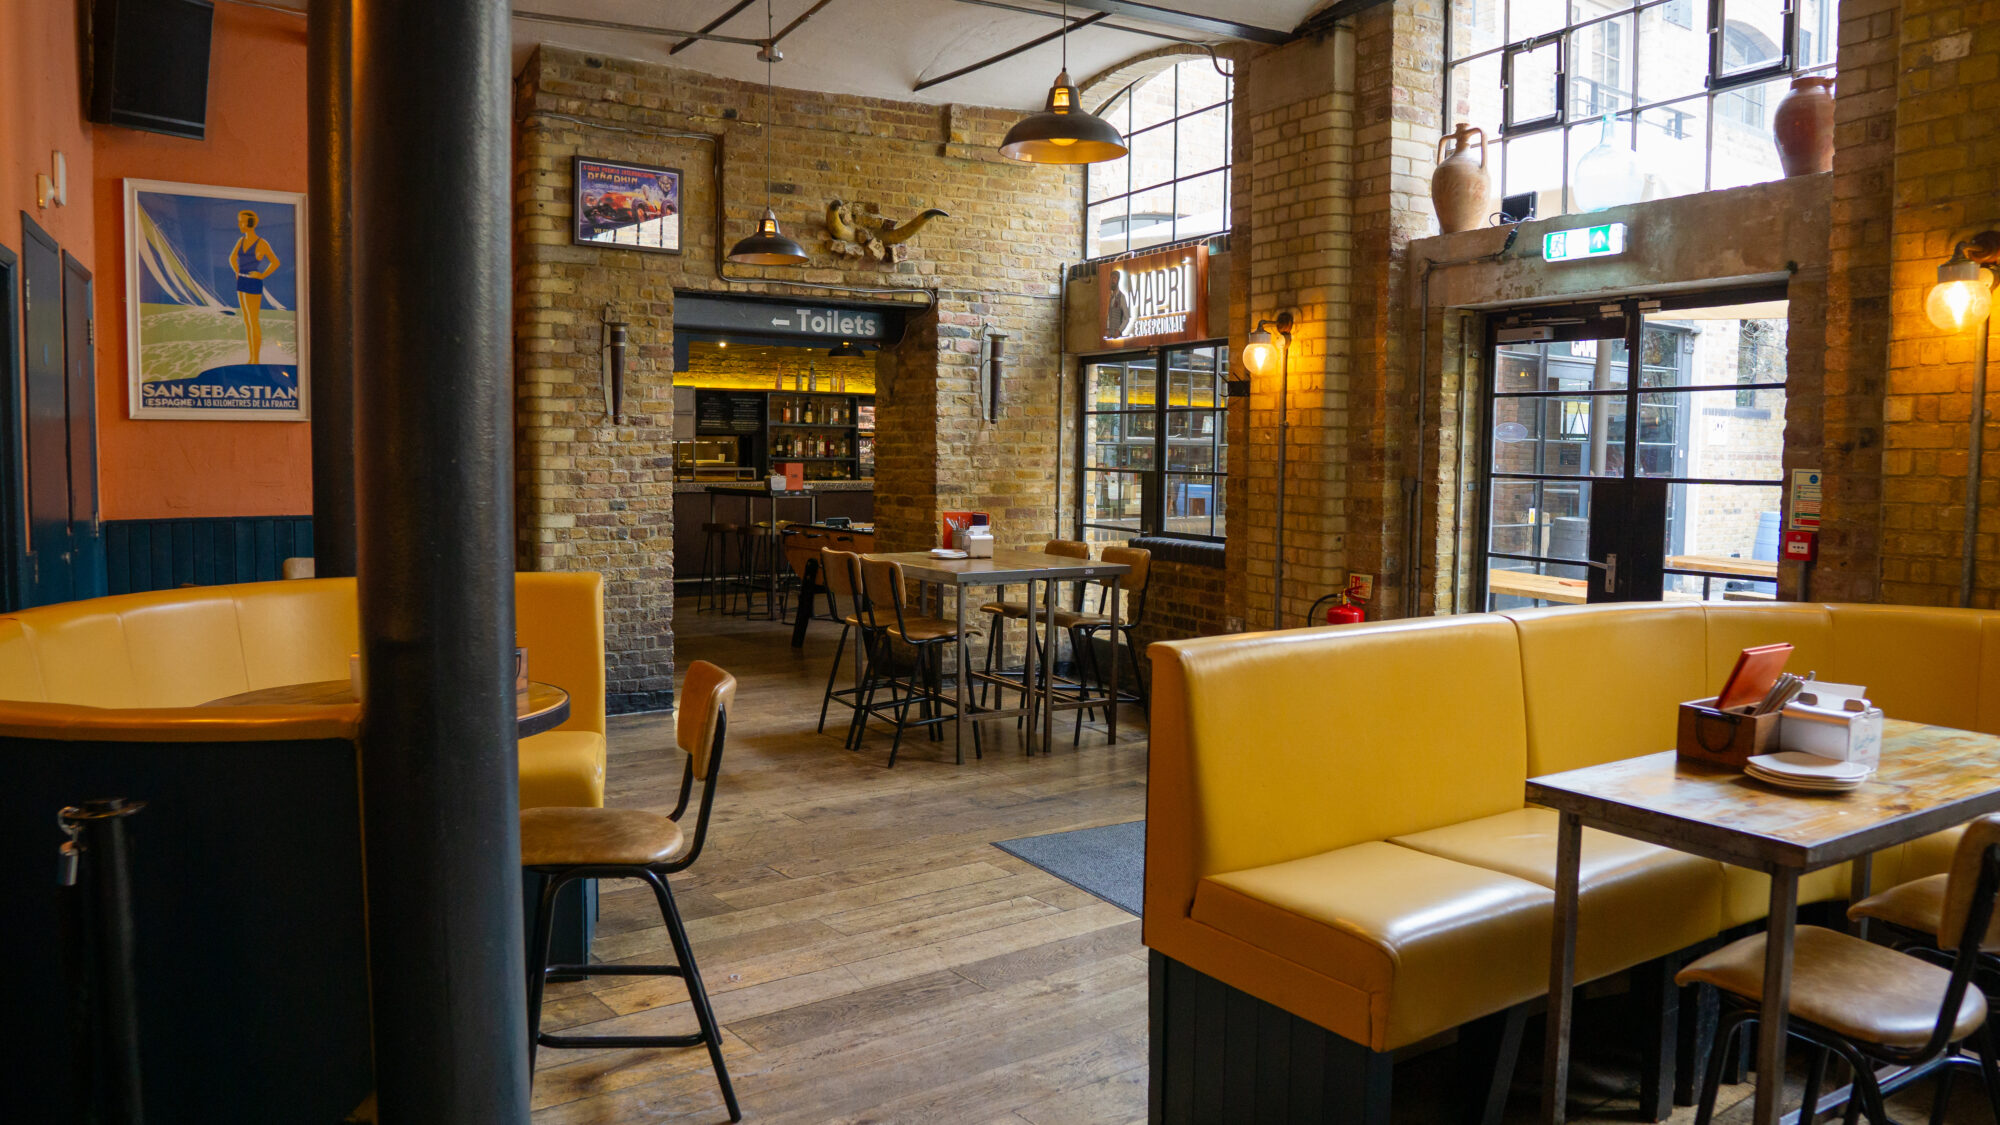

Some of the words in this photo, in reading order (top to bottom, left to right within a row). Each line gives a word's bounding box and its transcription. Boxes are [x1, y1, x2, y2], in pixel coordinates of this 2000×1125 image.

[796, 309, 876, 336] Toilets
[142, 384, 184, 398] SAN
[188, 384, 298, 399] SEBASTIAN
[203, 398, 212, 407] 18
[252, 399, 261, 408] DE
[262, 399, 270, 408] LA
[271, 399, 296, 408] FRANCE
